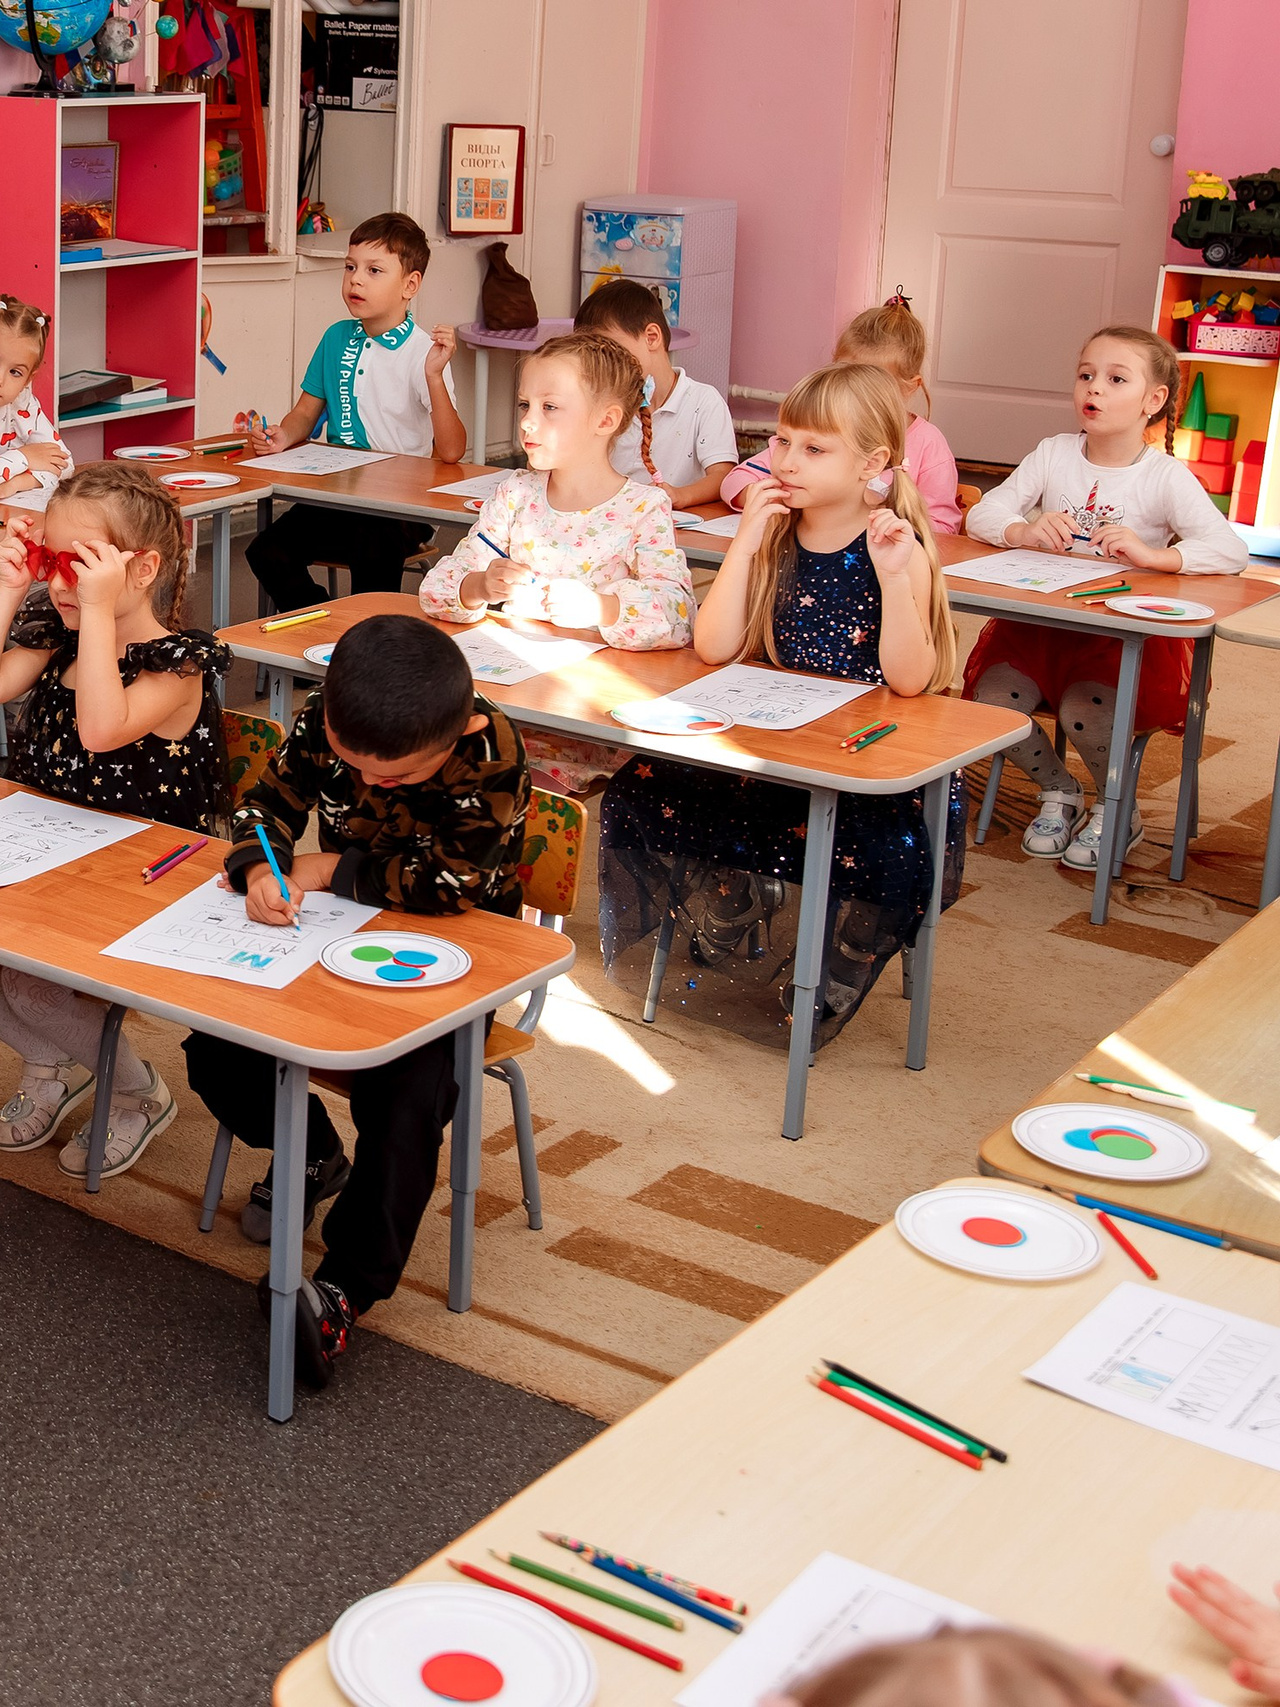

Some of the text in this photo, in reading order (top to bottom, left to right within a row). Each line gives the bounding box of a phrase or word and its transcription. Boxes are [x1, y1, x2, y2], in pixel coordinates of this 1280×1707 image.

[348, 21, 371, 31] Paper
[373, 24, 399, 32] matter
[359, 82, 396, 106] Ballet
[467, 144, 500, 155] ВИДЫ
[460, 158, 506, 169] СПОРТА
[340, 338, 360, 368] STAY
[339, 370, 352, 428] PLUGGED
[340, 432, 356, 445] IN
[274, 677, 281, 696] 1
[826, 806, 833, 832] 1
